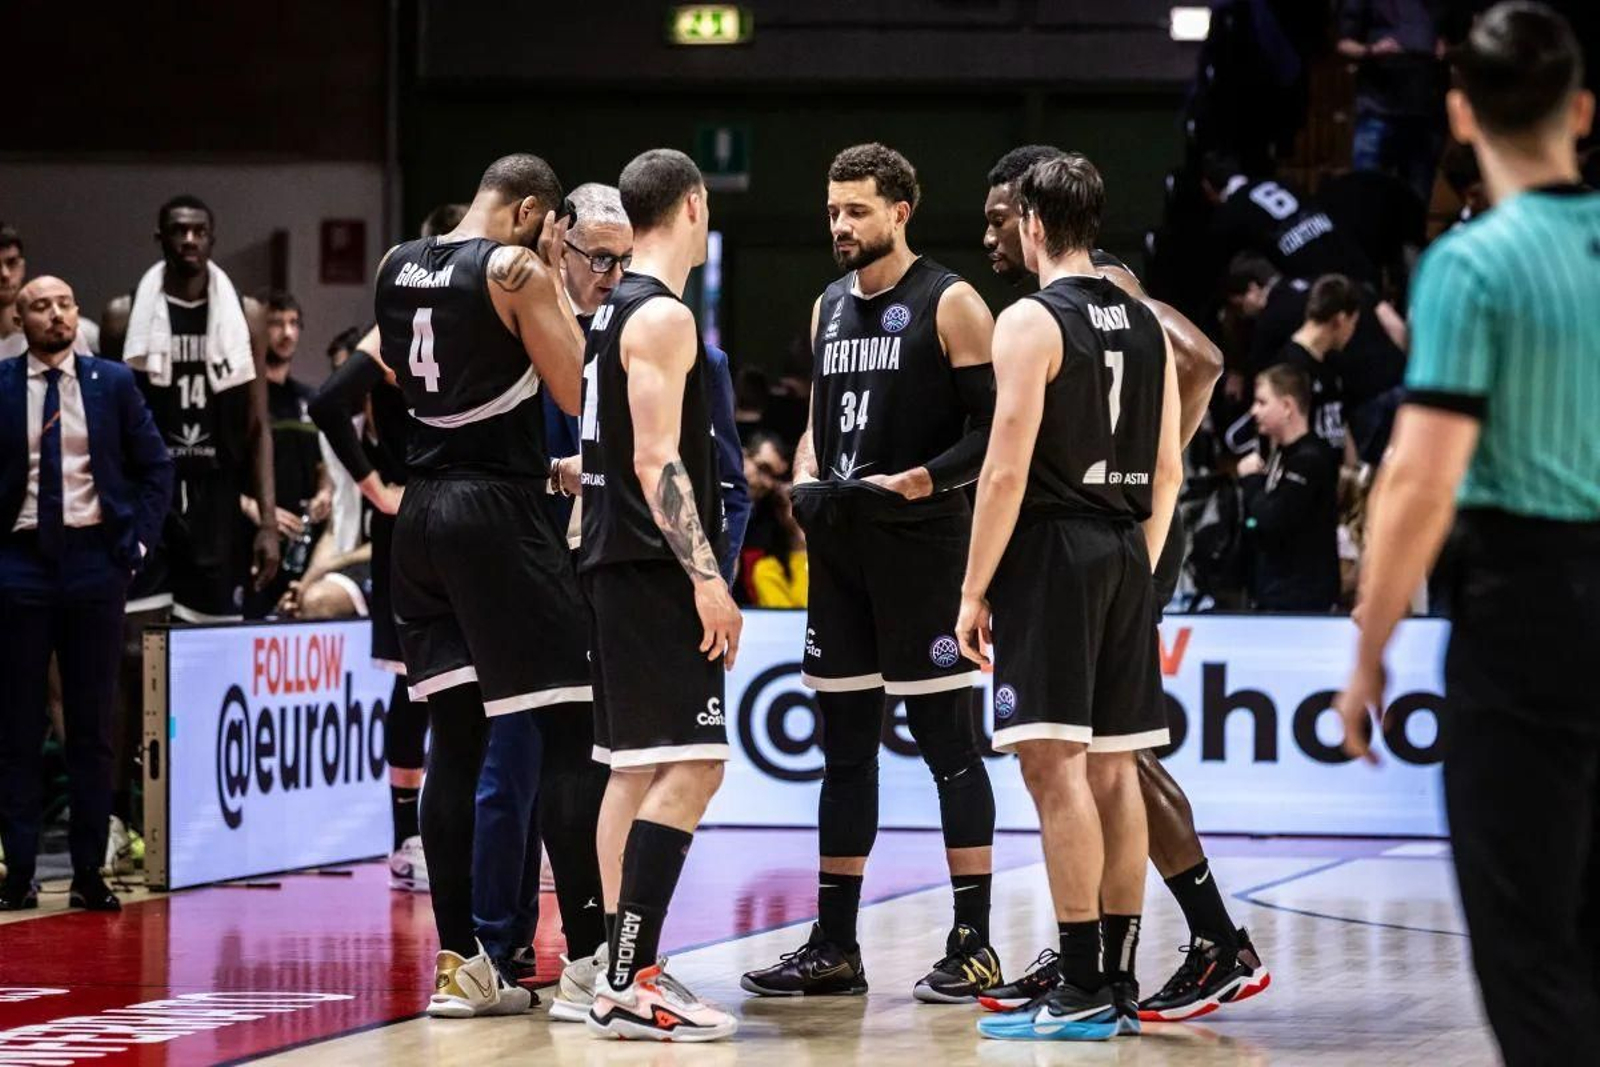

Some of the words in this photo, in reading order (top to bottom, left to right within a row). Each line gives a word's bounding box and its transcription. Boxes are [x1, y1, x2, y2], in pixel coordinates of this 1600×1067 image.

[1249, 181, 1299, 219] 6
[409, 308, 440, 393] 4
[823, 337, 901, 376] DERTHONA
[177, 374, 207, 410] 14
[840, 390, 870, 433] 34
[1104, 350, 1124, 435] 7
[1124, 472, 1149, 485] ASTM
[252, 633, 345, 697] FOLLOW
[613, 910, 642, 987] ARMOUR
